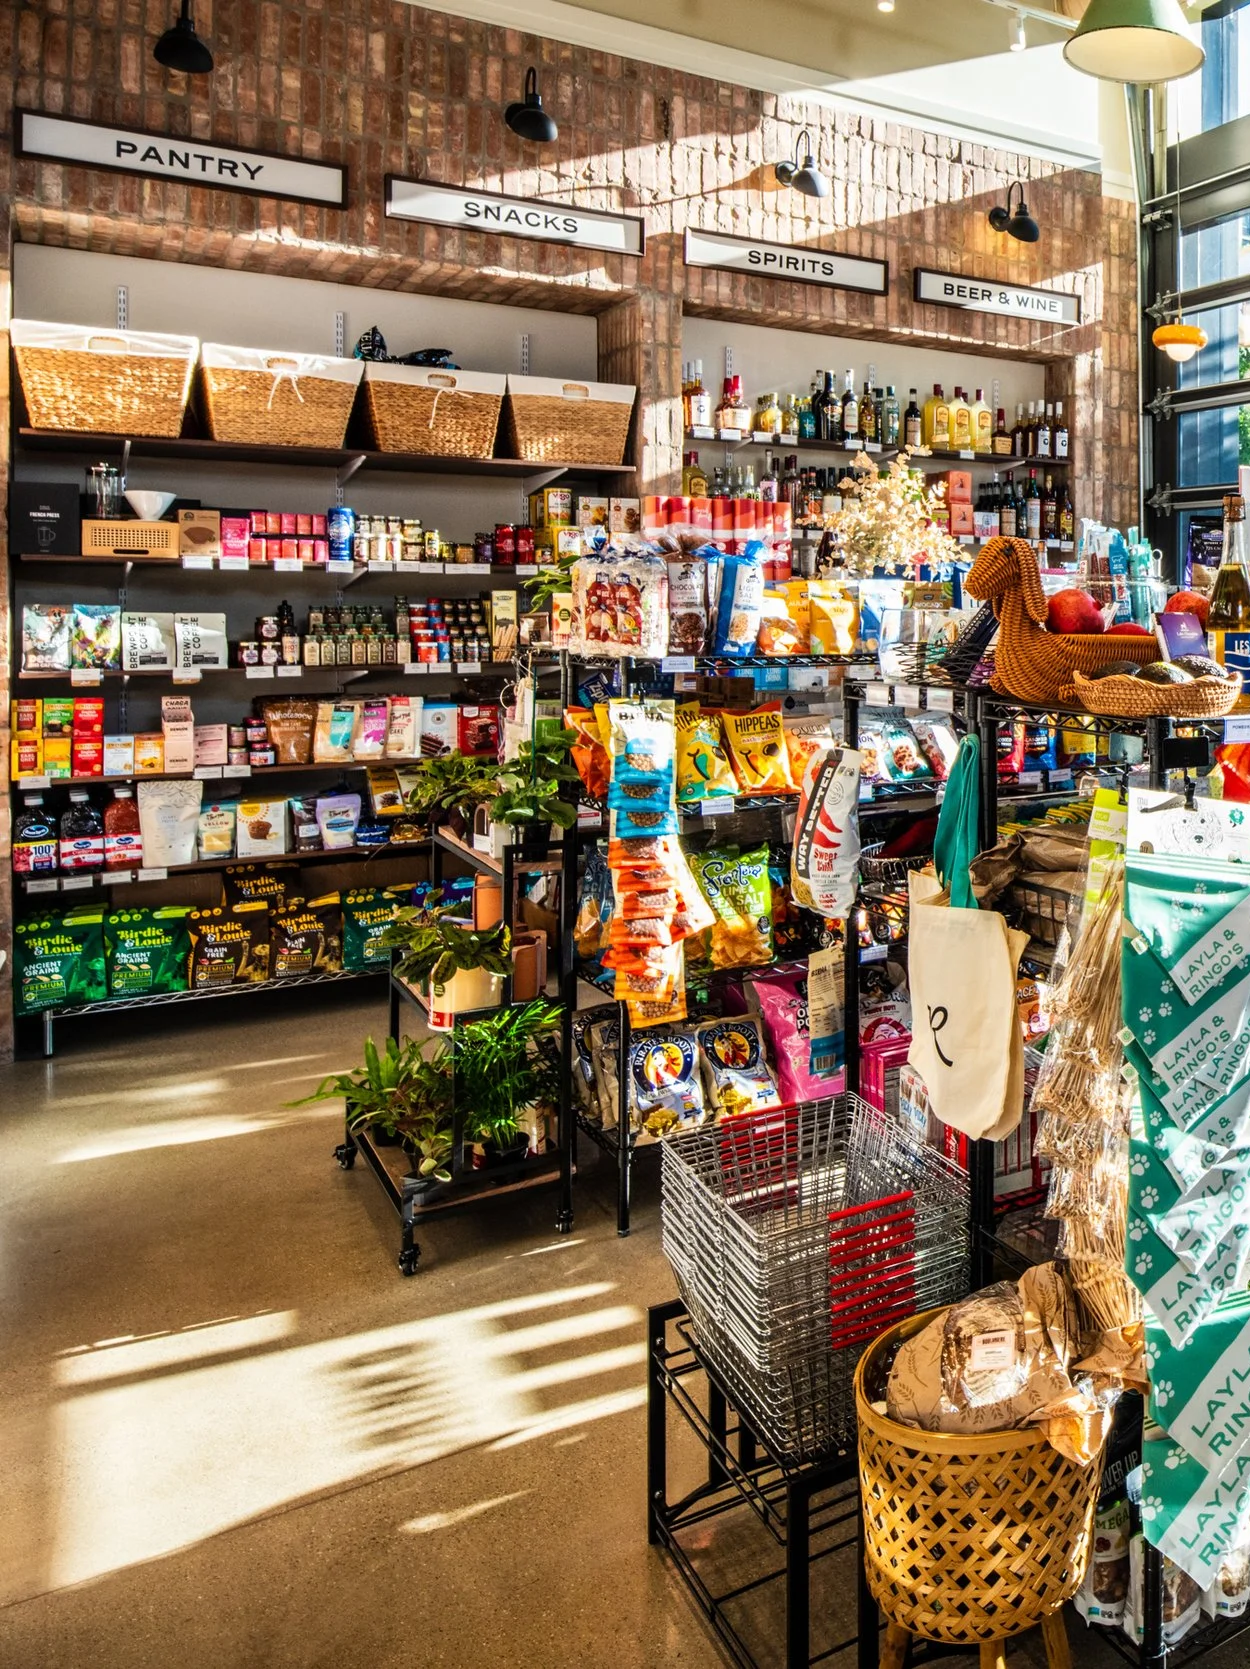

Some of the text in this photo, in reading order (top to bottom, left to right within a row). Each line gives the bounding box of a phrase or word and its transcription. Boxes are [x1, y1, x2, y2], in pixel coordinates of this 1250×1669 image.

[115, 139, 265, 181] PANTRY
[464, 201, 580, 235] SNACKS
[747, 249, 834, 277] SPIRITS
[943, 282, 1059, 314] BEER & WINE
[182, 616, 192, 668] BREWPOINT
[734, 714, 780, 734] HIPPEAS
[797, 770, 834, 871] WAY BETTER
[813, 848, 838, 861] Sweet
[234, 875, 277, 889] Birdie
[702, 860, 764, 897] Frontera
[250, 882, 286, 896] Louie
[722, 885, 756, 897] LIME &
[736, 891, 765, 905] SALT
[276, 913, 317, 927] Birdie
[352, 907, 392, 921] Birdie
[117, 927, 164, 941] Birdie
[198, 921, 242, 936] Birdie
[292, 921, 325, 935] Louie
[24, 934, 73, 950] Birdie
[125, 935, 173, 948] & Louie
[215, 929, 252, 943] Louie
[33, 943, 84, 957] & Louie
[115, 951, 151, 960] ANCIENT
[204, 946, 228, 954] GRAIN
[1179, 928, 1236, 985] LAYLA &
[277, 954, 312, 962] PREMIUM
[23, 960, 62, 972] ANCIENT
[25, 966, 59, 977] GRAINS
[198, 964, 233, 972] PREMIUM
[1189, 942, 1245, 998] RINGO'S
[114, 970, 151, 979] PREMIUM
[24, 980, 64, 992] PREMIUM
[728, 1023, 756, 1041] BOOTY
[1162, 1025, 1211, 1072] LAYLA
[1212, 1014, 1225, 1029] &
[634, 1035, 693, 1067] PIRATE'S BOOTY
[1172, 1029, 1232, 1085] RINGO'S
[1172, 1078, 1206, 1112] LAY
[1181, 1088, 1218, 1125] RING
[1218, 1116, 1231, 1130] &
[1233, 1223, 1249, 1239] &
[1125, 1449, 1139, 1473] UP
